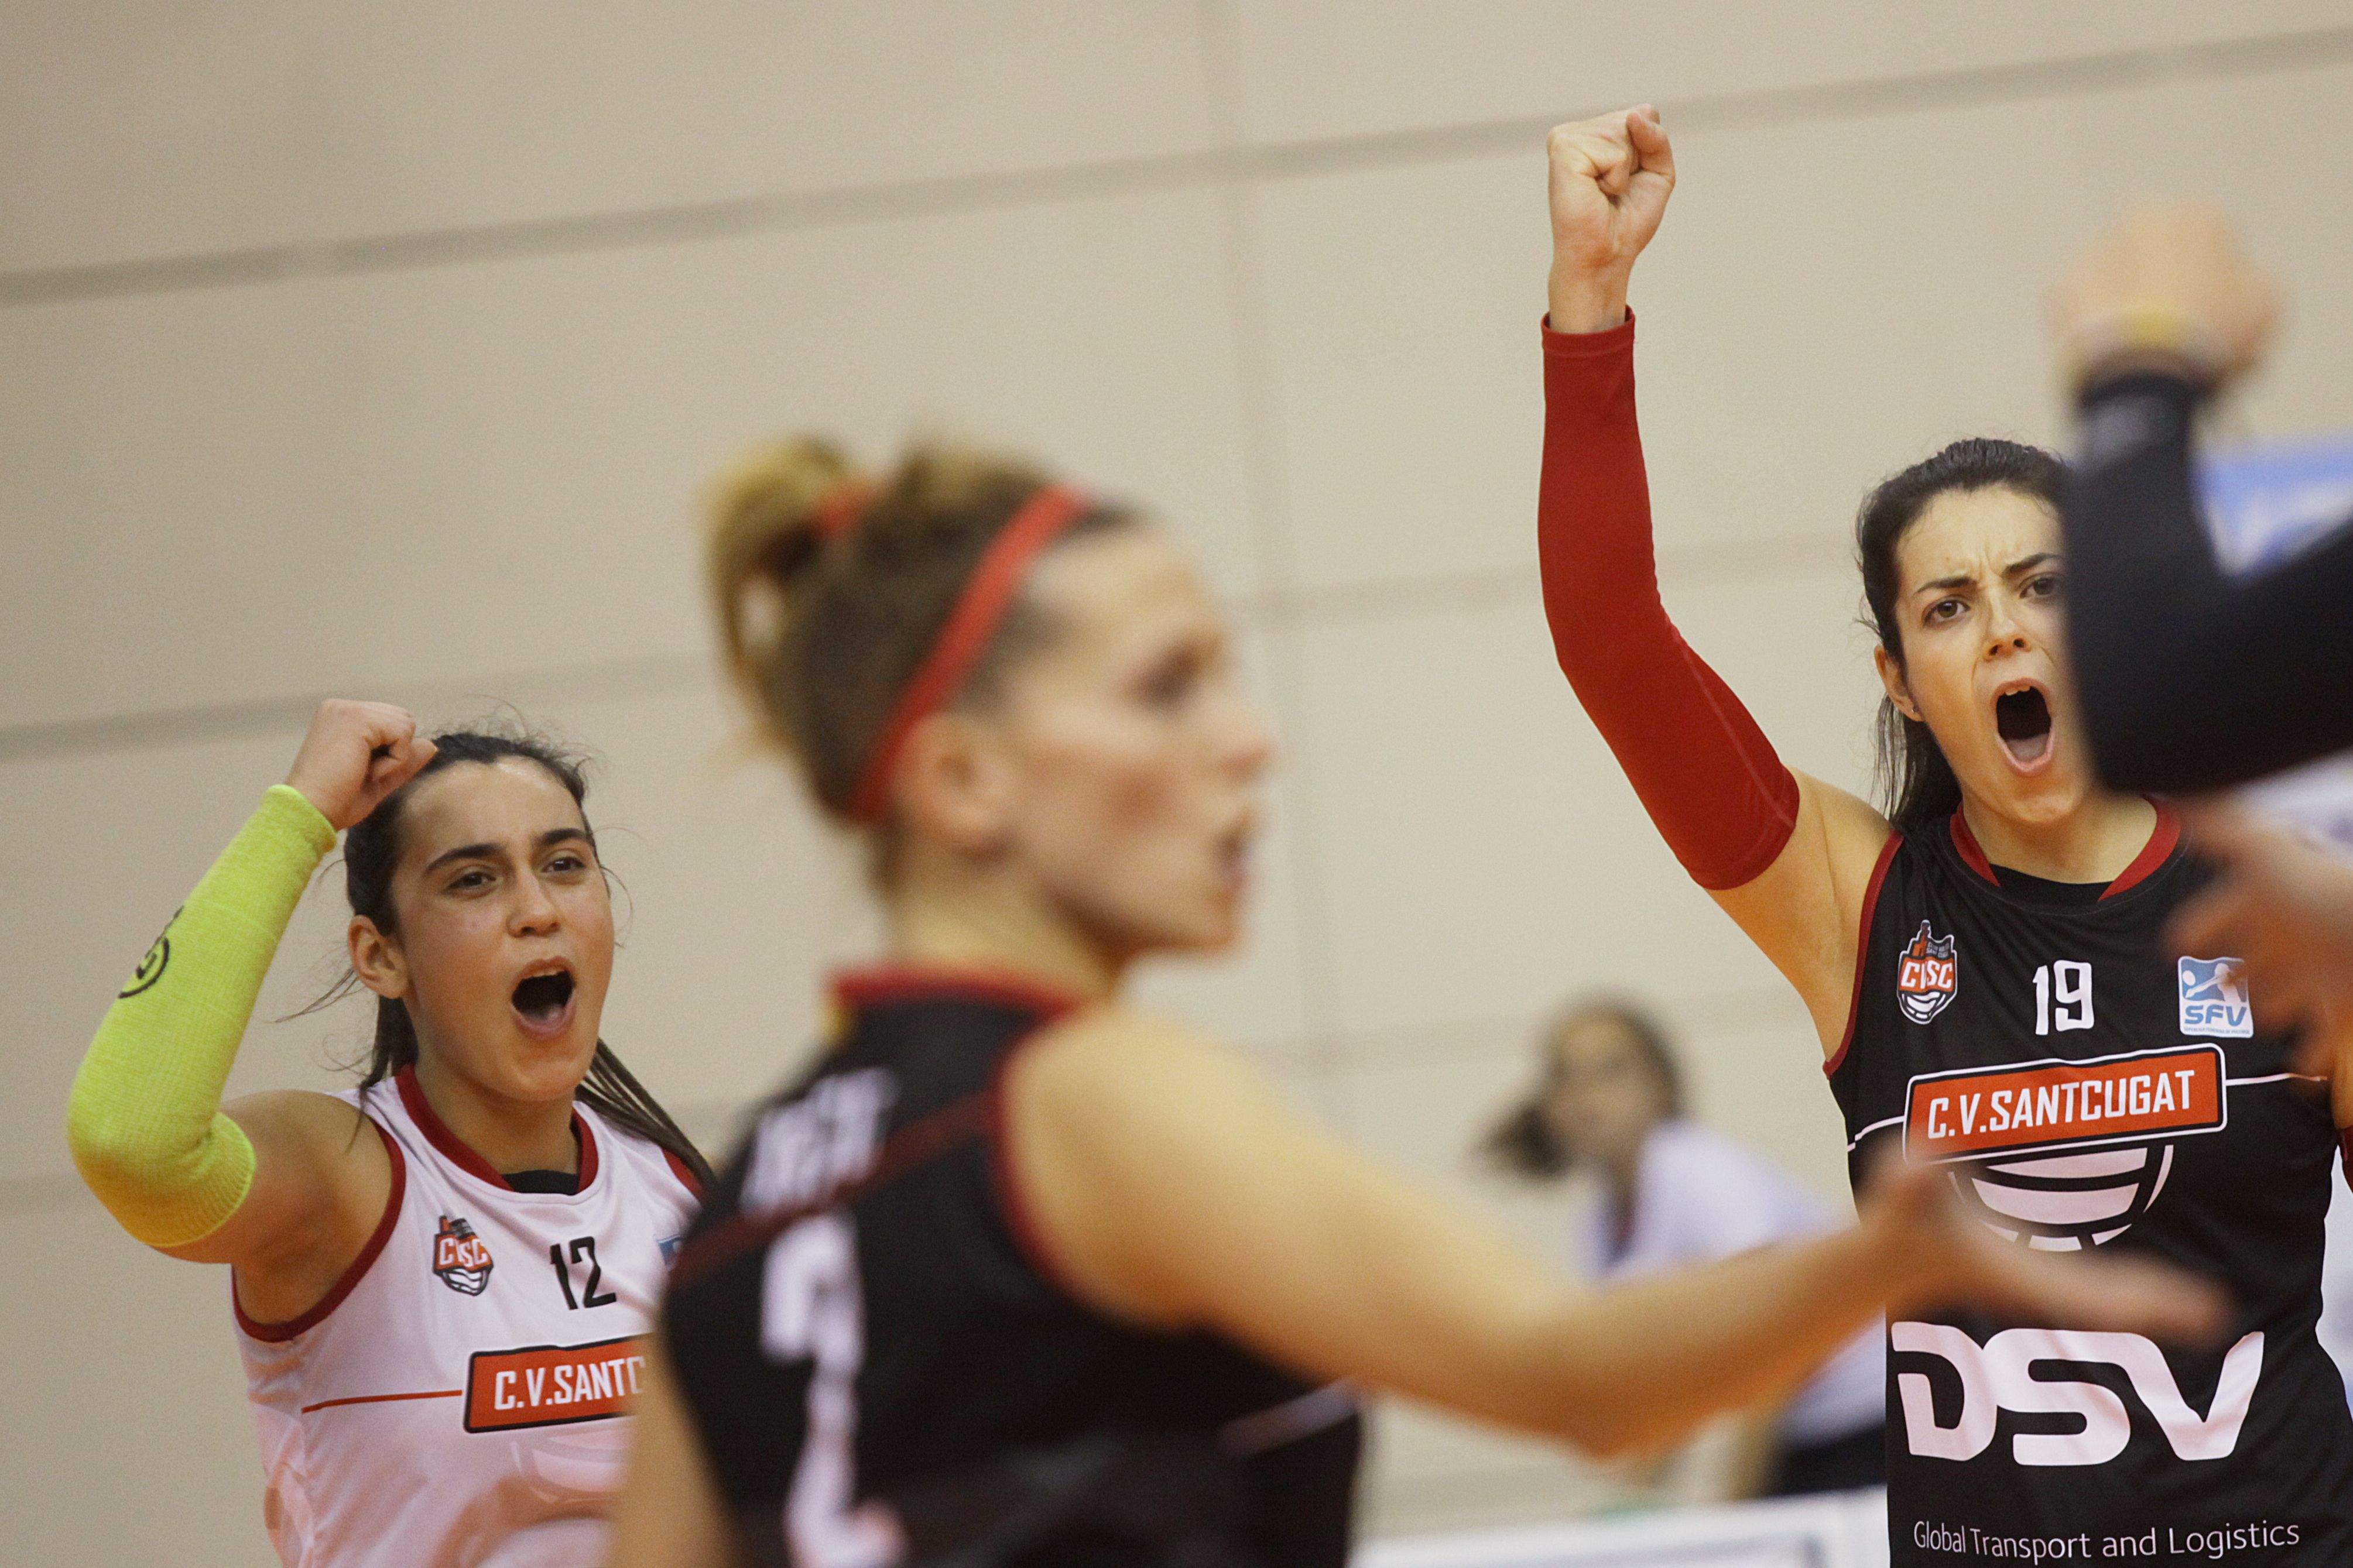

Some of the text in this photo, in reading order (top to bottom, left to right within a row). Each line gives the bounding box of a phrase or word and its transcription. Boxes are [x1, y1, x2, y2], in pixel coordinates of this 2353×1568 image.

[2033, 960, 2094, 1035] 19
[2184, 1004, 2247, 1027] SFV
[1928, 1069, 2195, 1139] C.V.SANTCUGAT
[550, 1236, 616, 1310] 12
[494, 1356, 645, 1411] C.V.SANTC
[1891, 1321, 2265, 1466] DSV
[1913, 1520, 2300, 1566] Global Transport and Logistics
